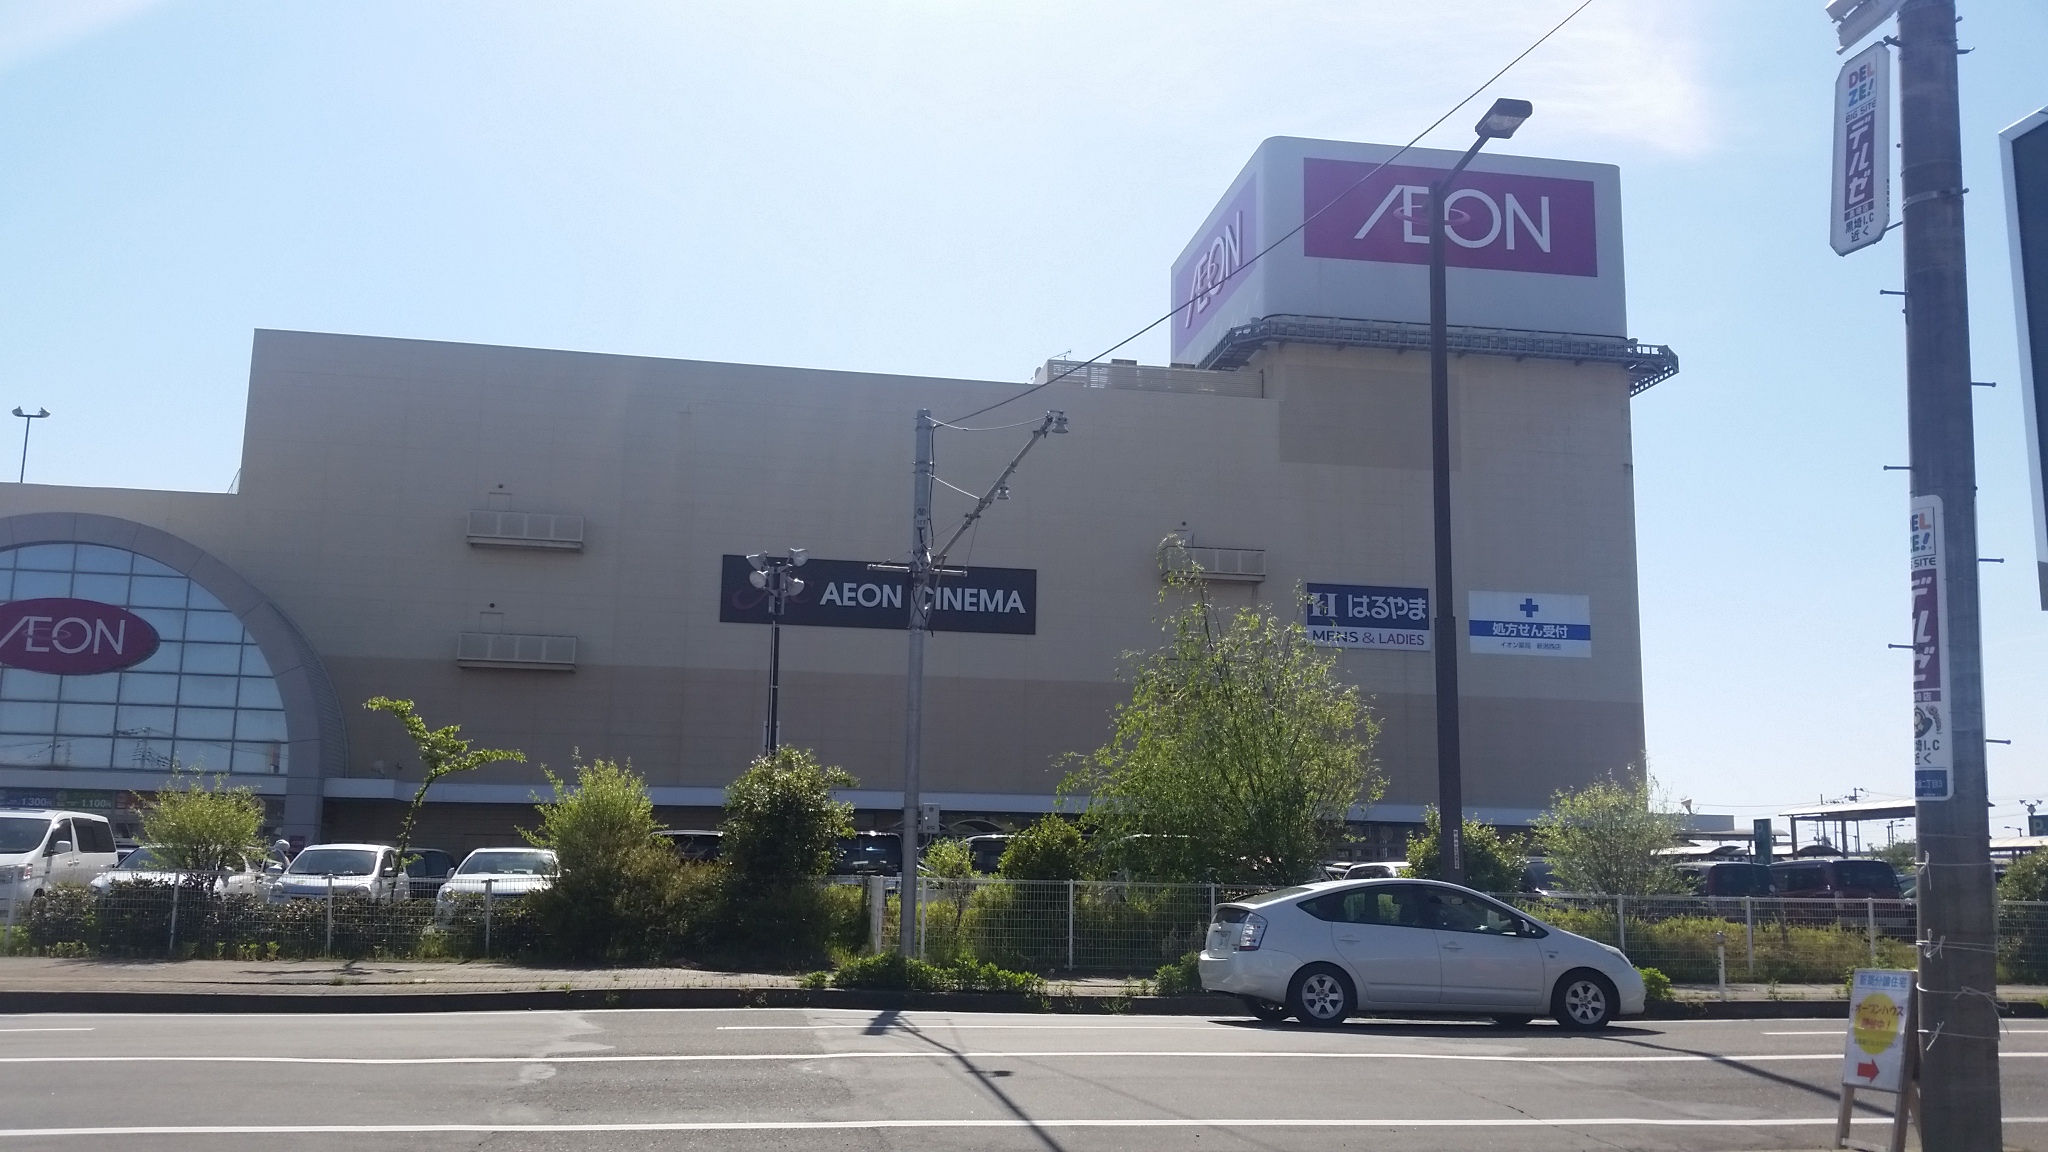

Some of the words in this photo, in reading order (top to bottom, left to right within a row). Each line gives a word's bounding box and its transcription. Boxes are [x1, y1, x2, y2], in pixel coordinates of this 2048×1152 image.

[1849, 62, 1874, 88] DEL
[1849, 78, 1874, 107] ZE!
[1846, 110, 1858, 123] BIG
[1860, 99, 1876, 115] SITE
[1848, 114, 1872, 204] デルゼ
[1851, 226, 1869, 243] 近く
[1910, 513, 1931, 532] EL
[1911, 532, 1930, 552] E!
[1914, 557, 1936, 568] SITE
[820, 581, 902, 608] AEON
[1347, 594, 1426, 621] はるやま
[1312, 630, 1358, 643] MENS
[1362, 632, 1375, 644] &
[1379, 633, 1425, 646] LADIES
[1492, 622, 1568, 638] 処方せん受付
[1860, 974, 1907, 988] 新築分譲住宅
[1855, 1003, 1904, 1016] オープンハウス
